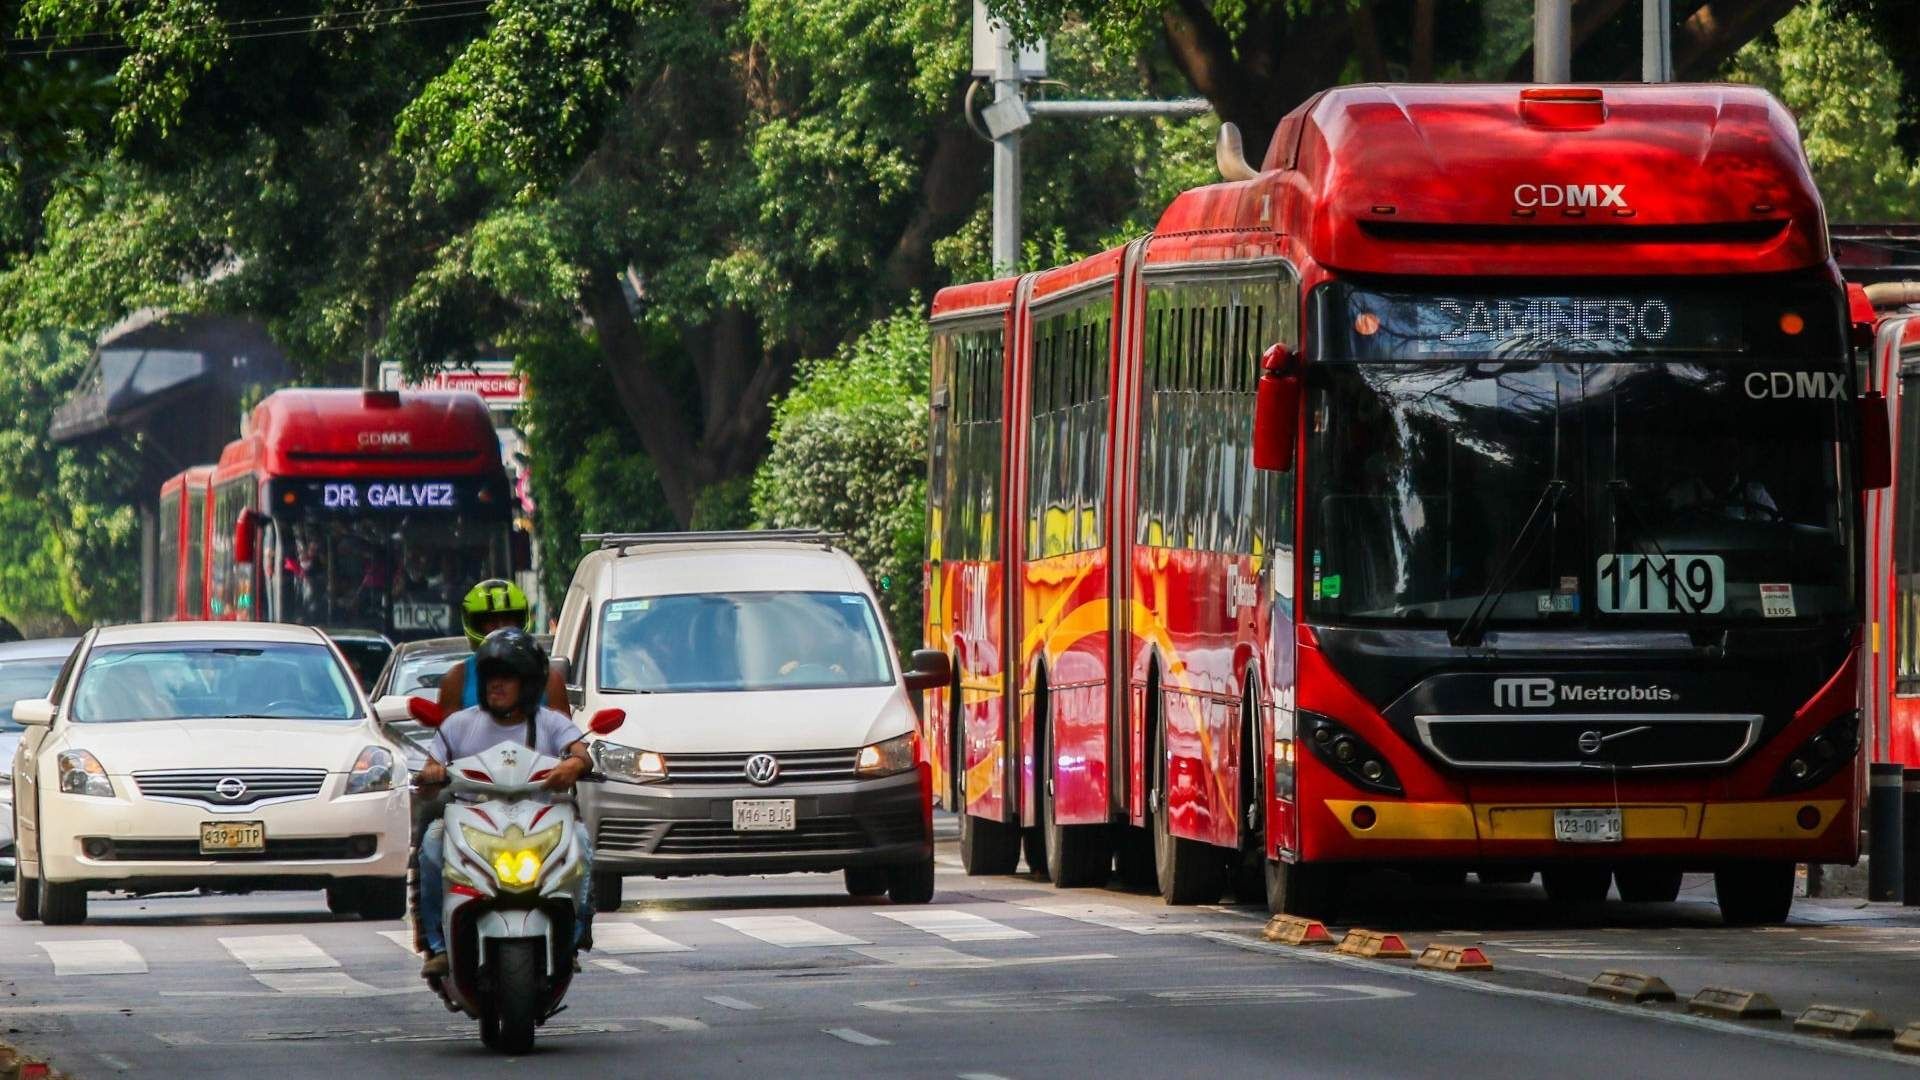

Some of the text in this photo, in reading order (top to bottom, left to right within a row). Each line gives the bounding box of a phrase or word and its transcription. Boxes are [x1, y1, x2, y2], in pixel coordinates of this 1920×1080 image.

[1513, 184, 1628, 207] CDMX
[1744, 371, 1848, 400] CDMX
[357, 431, 411, 445] CDMX
[323, 484, 453, 507] DR. GALVEZ
[1601, 557, 1713, 611] 1119
[1559, 818, 1620, 833] 123-01-10
